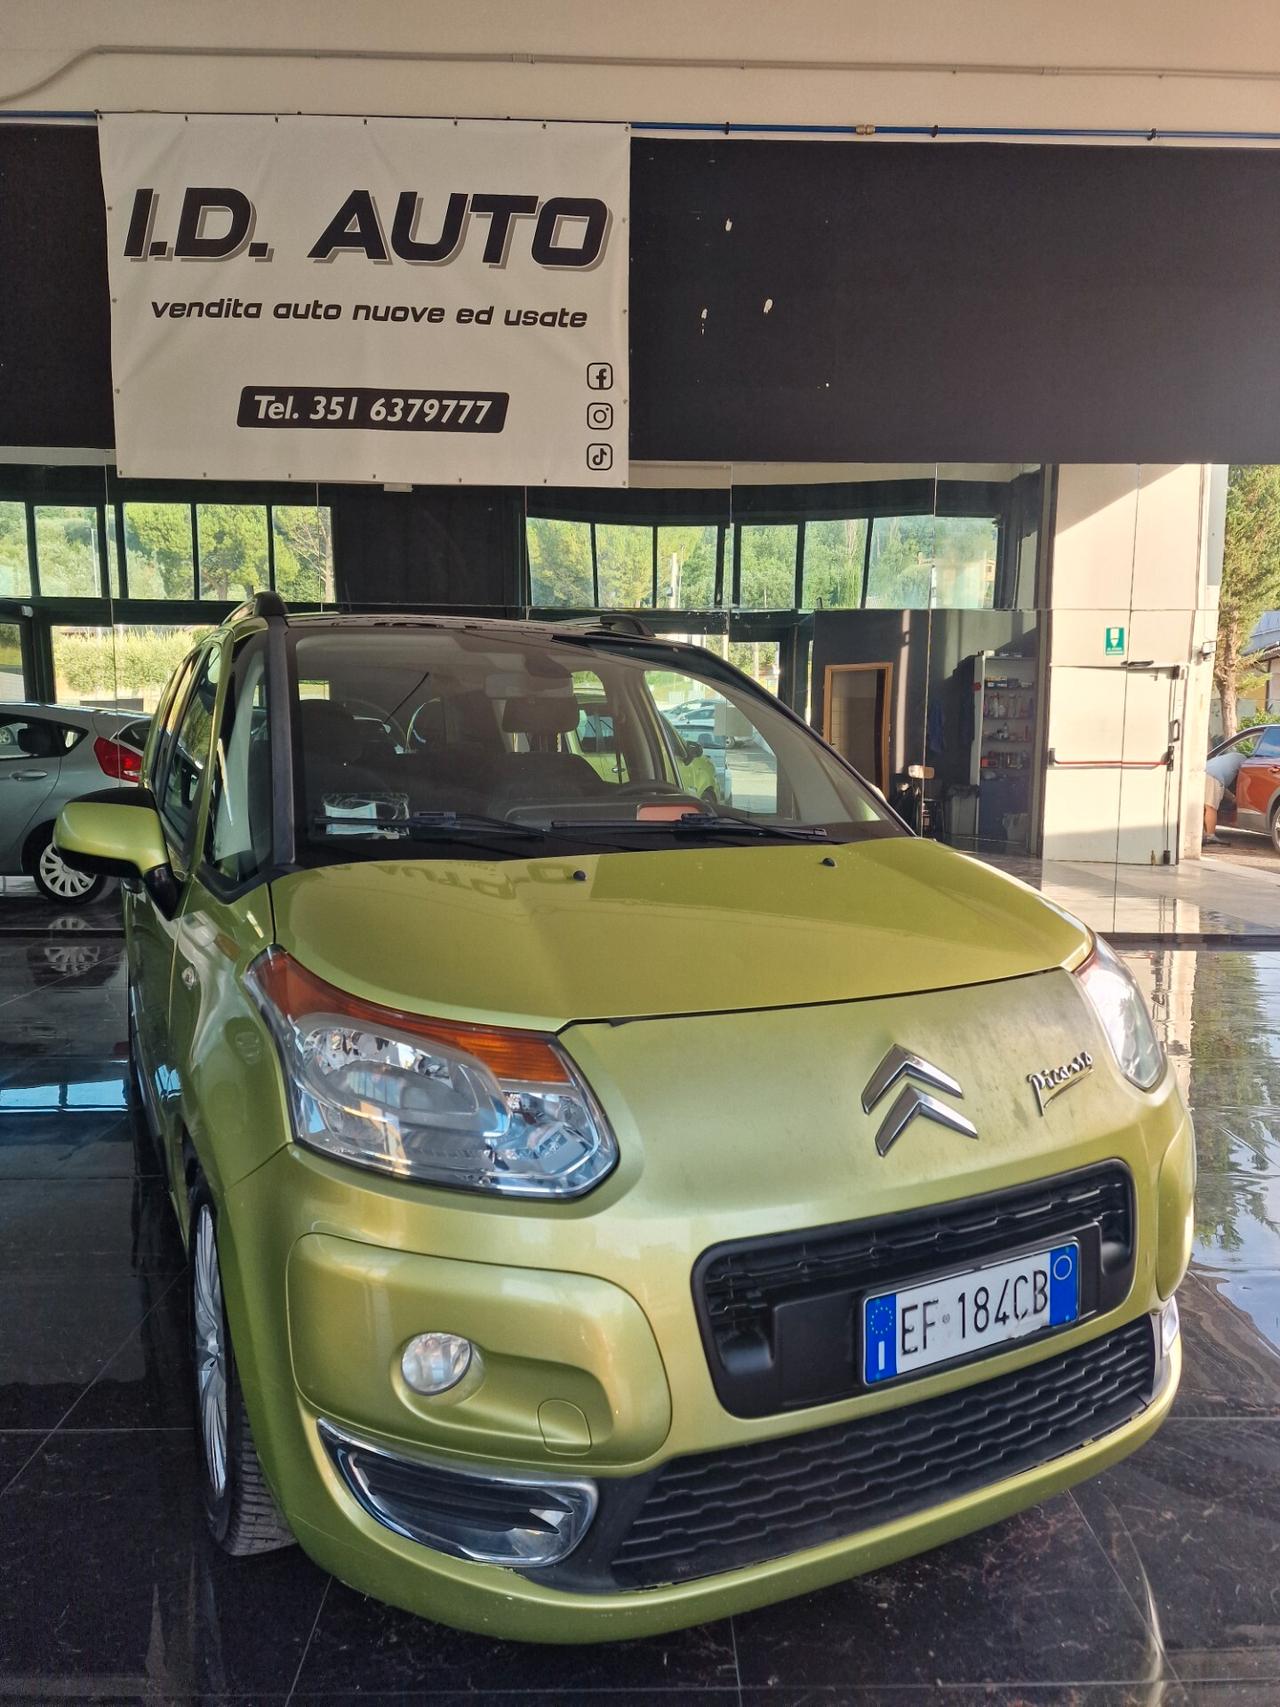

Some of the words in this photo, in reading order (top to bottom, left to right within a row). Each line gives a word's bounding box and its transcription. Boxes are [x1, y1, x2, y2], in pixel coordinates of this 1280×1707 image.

[123, 187, 274, 262] I.D.
[307, 190, 613, 271] AUTO
[151, 298, 263, 319] vendita
[273, 300, 342, 320] auto
[352, 305, 446, 324] nuove
[456, 306, 495, 326] ed
[504, 308, 588, 328] usate
[254, 396, 299, 420] Tel.
[310, 396, 358, 420] 351
[370, 398, 493, 425] 6379777
